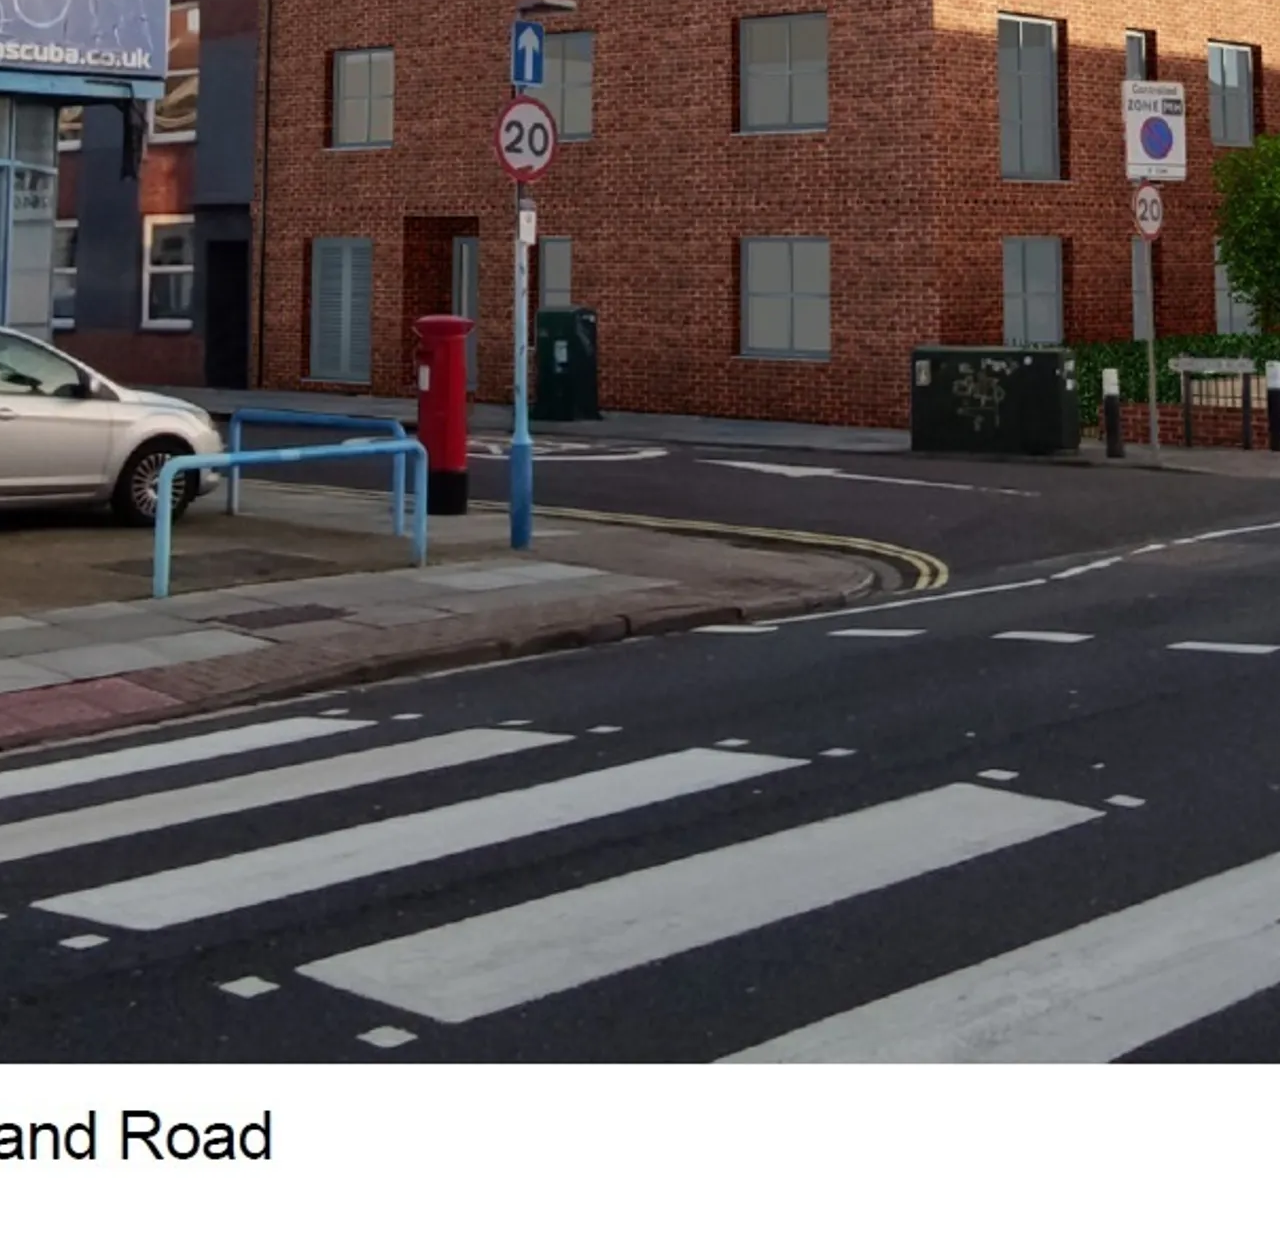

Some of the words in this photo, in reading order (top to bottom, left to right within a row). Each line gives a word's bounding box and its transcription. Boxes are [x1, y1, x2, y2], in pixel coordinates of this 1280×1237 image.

[1127, 98, 1160, 113] ZONE
[504, 120, 550, 157] 20
[1138, 197, 1161, 222] 20
